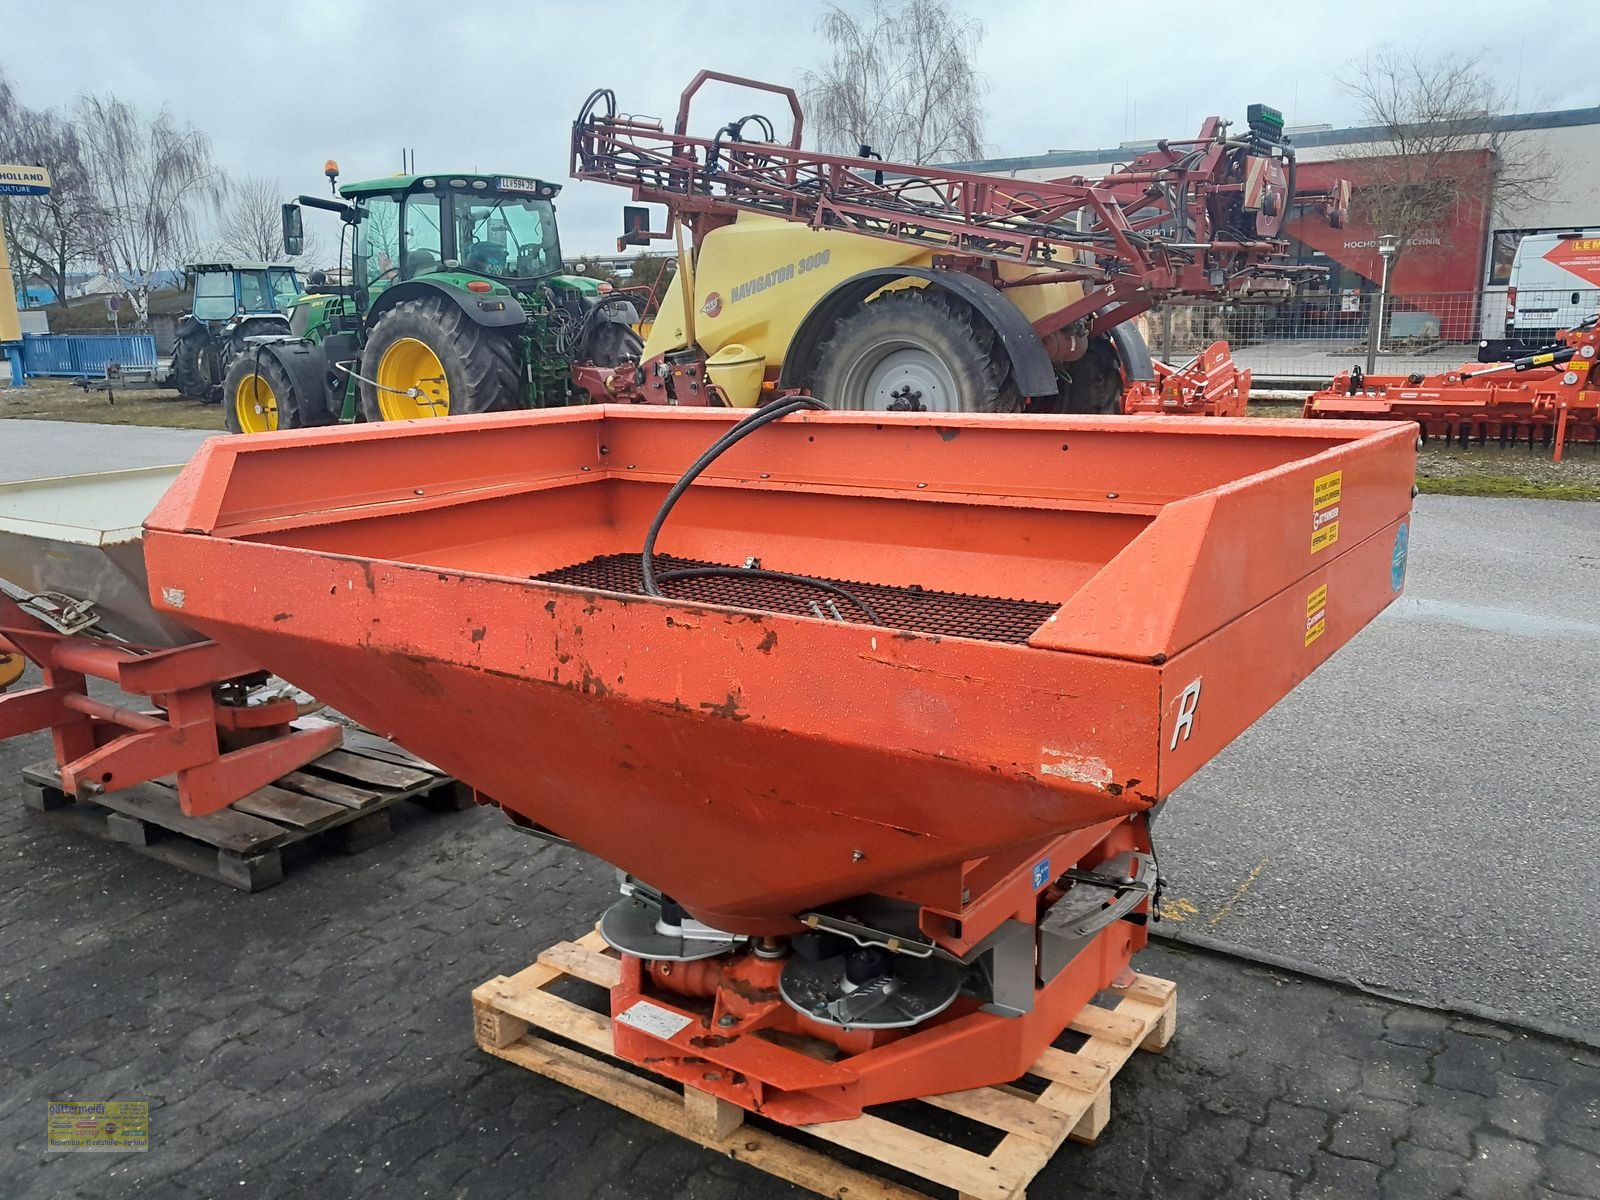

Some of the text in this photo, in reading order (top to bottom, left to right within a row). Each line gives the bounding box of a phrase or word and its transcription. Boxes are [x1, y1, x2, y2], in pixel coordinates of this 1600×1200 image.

[0, 172, 44, 181] HOLLAND
[731, 249, 831, 304] NAVIGATOR 3000
[1170, 679, 1202, 752] R
